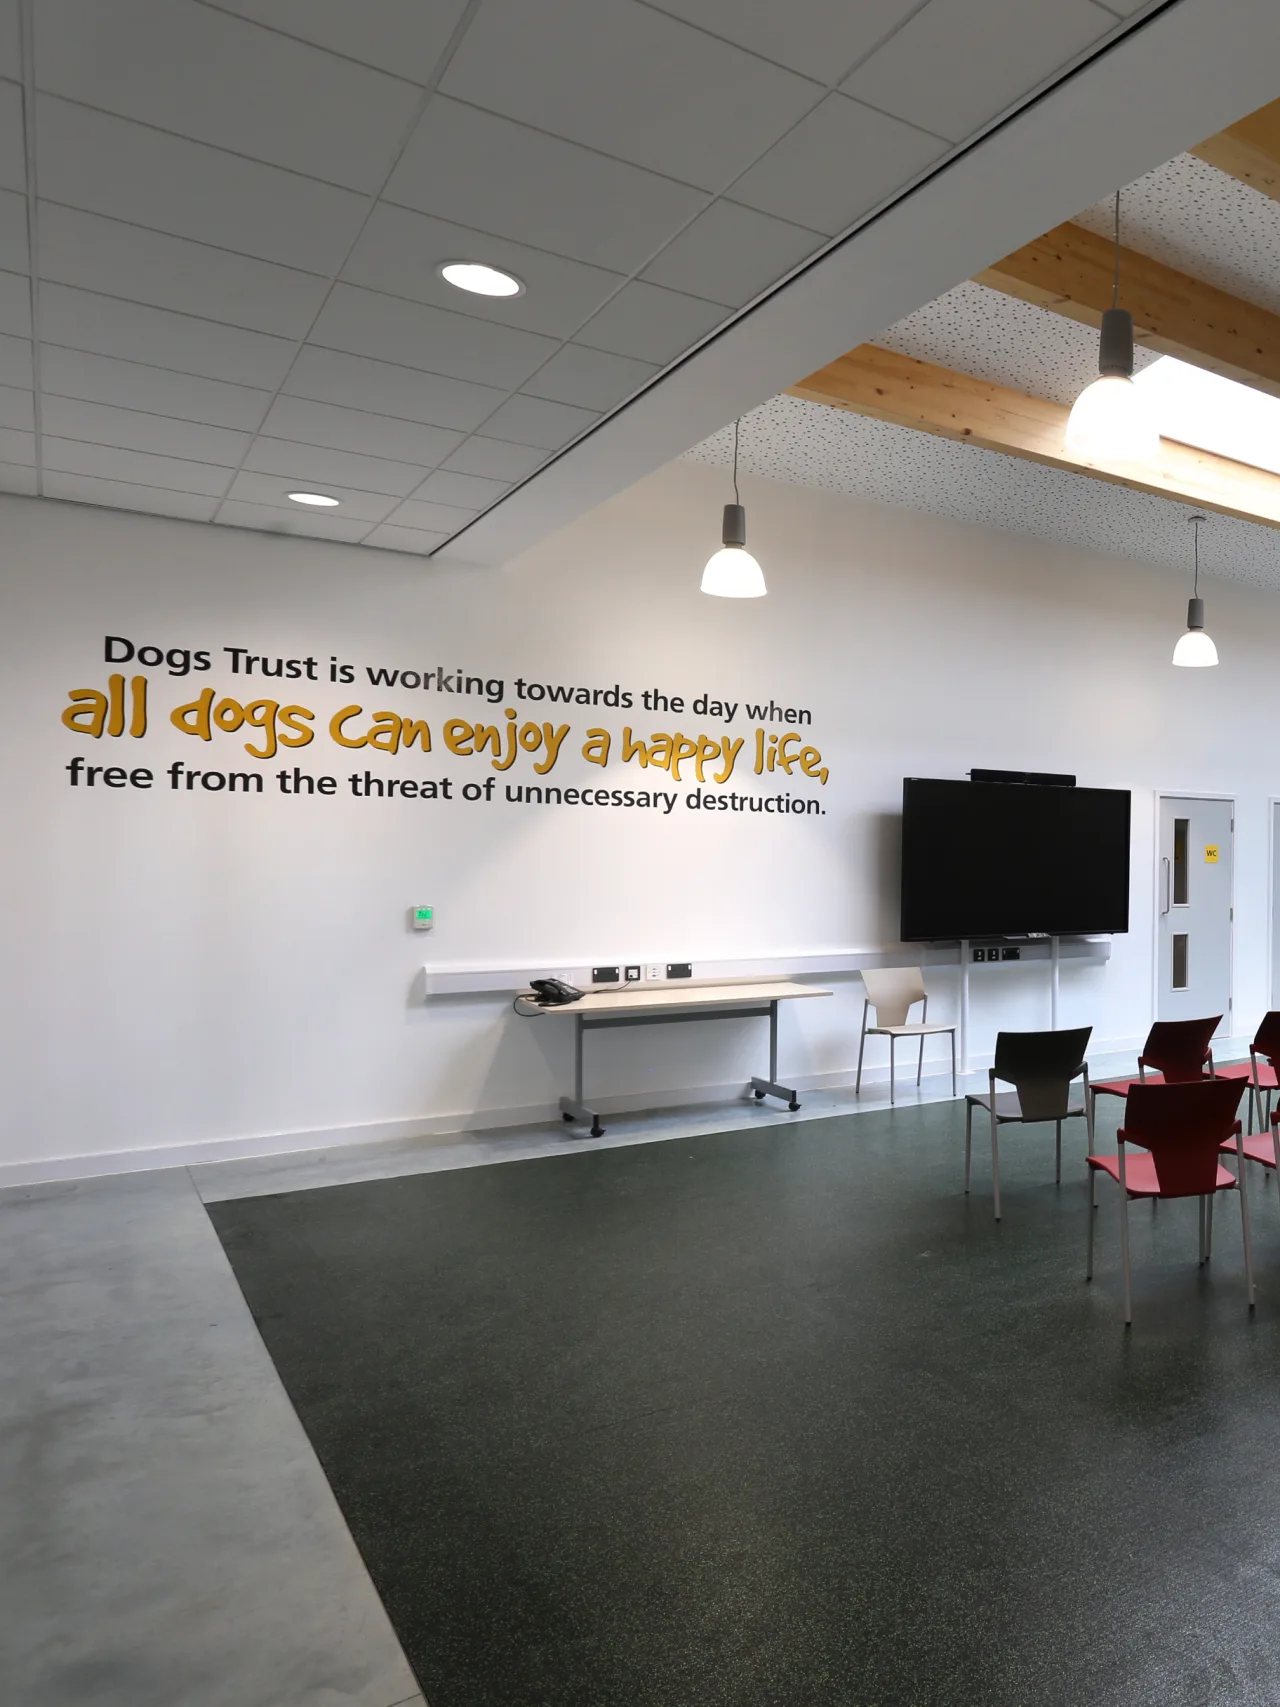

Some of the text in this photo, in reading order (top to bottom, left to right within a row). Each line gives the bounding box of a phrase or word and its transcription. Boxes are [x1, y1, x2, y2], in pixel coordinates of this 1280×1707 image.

[104, 636, 812, 725] Dogs Trust is working towards the day when
[61, 674, 149, 739] all
[169, 687, 315, 759] dogs
[443, 707, 571, 776] enjoy
[581, 727, 611, 768] a
[622, 725, 746, 784] happy
[754, 728, 830, 786] life,
[65, 757, 828, 815] free from the threat of unnecessary destruction.
[1206, 849, 1217, 857] WC
